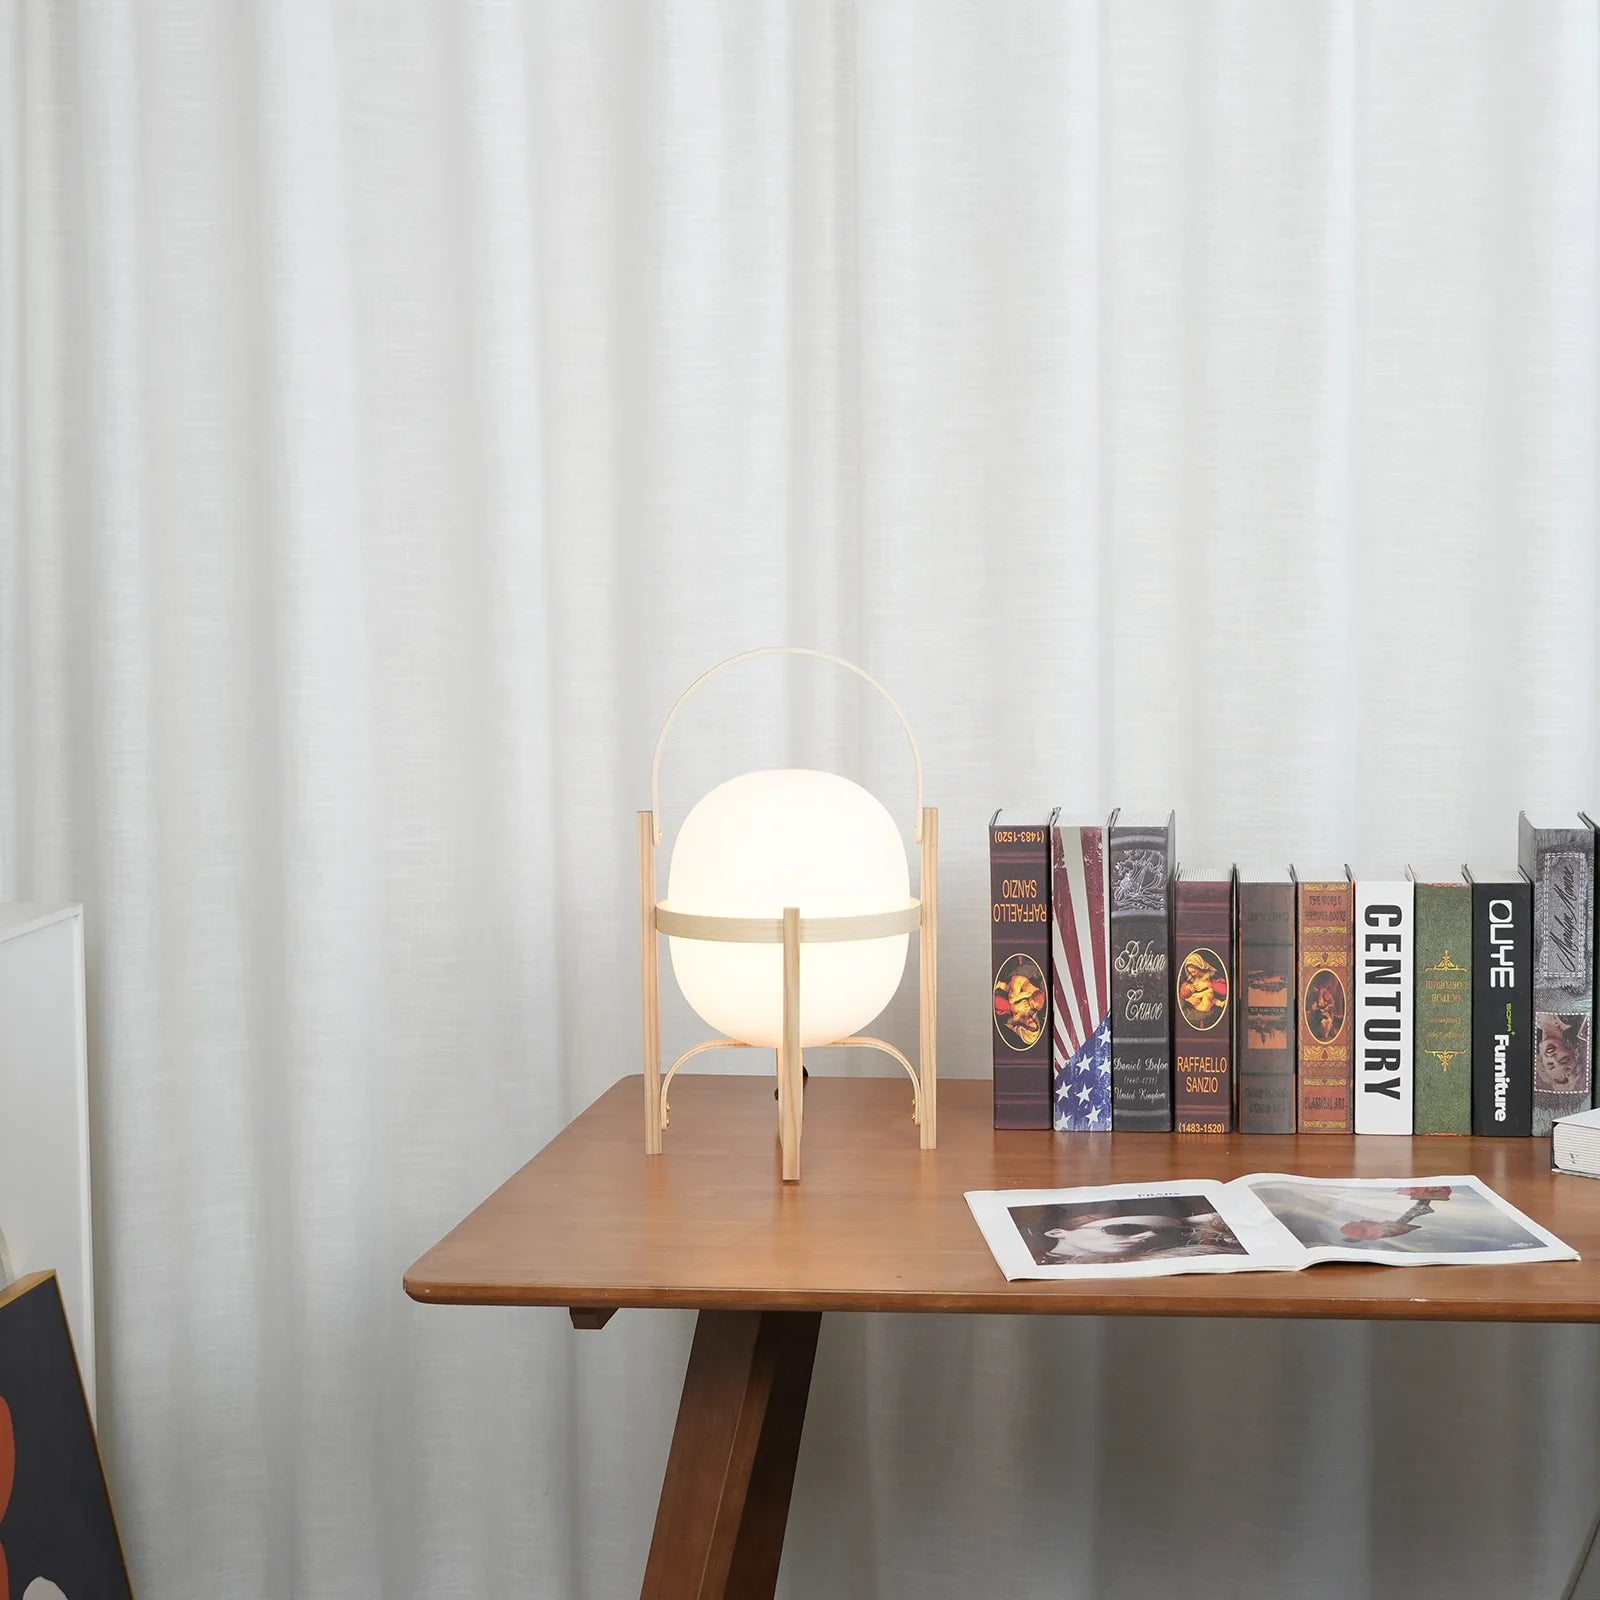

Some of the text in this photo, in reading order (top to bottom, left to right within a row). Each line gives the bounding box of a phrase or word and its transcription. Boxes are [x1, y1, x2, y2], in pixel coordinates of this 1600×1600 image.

[994, 831, 1045, 843] (1483-1520)
[1002, 880, 1037, 899] SANZIO
[993, 904, 1047, 922] RAFFAELLO
[1364, 904, 1403, 1100] CENTURY
[1113, 1057, 1142, 1071] Daniel
[1177, 1056, 1228, 1073] RAFFAELLO
[1185, 1076, 1219, 1093] SANZIO
[1178, 1123, 1225, 1133] (1483-1520)
